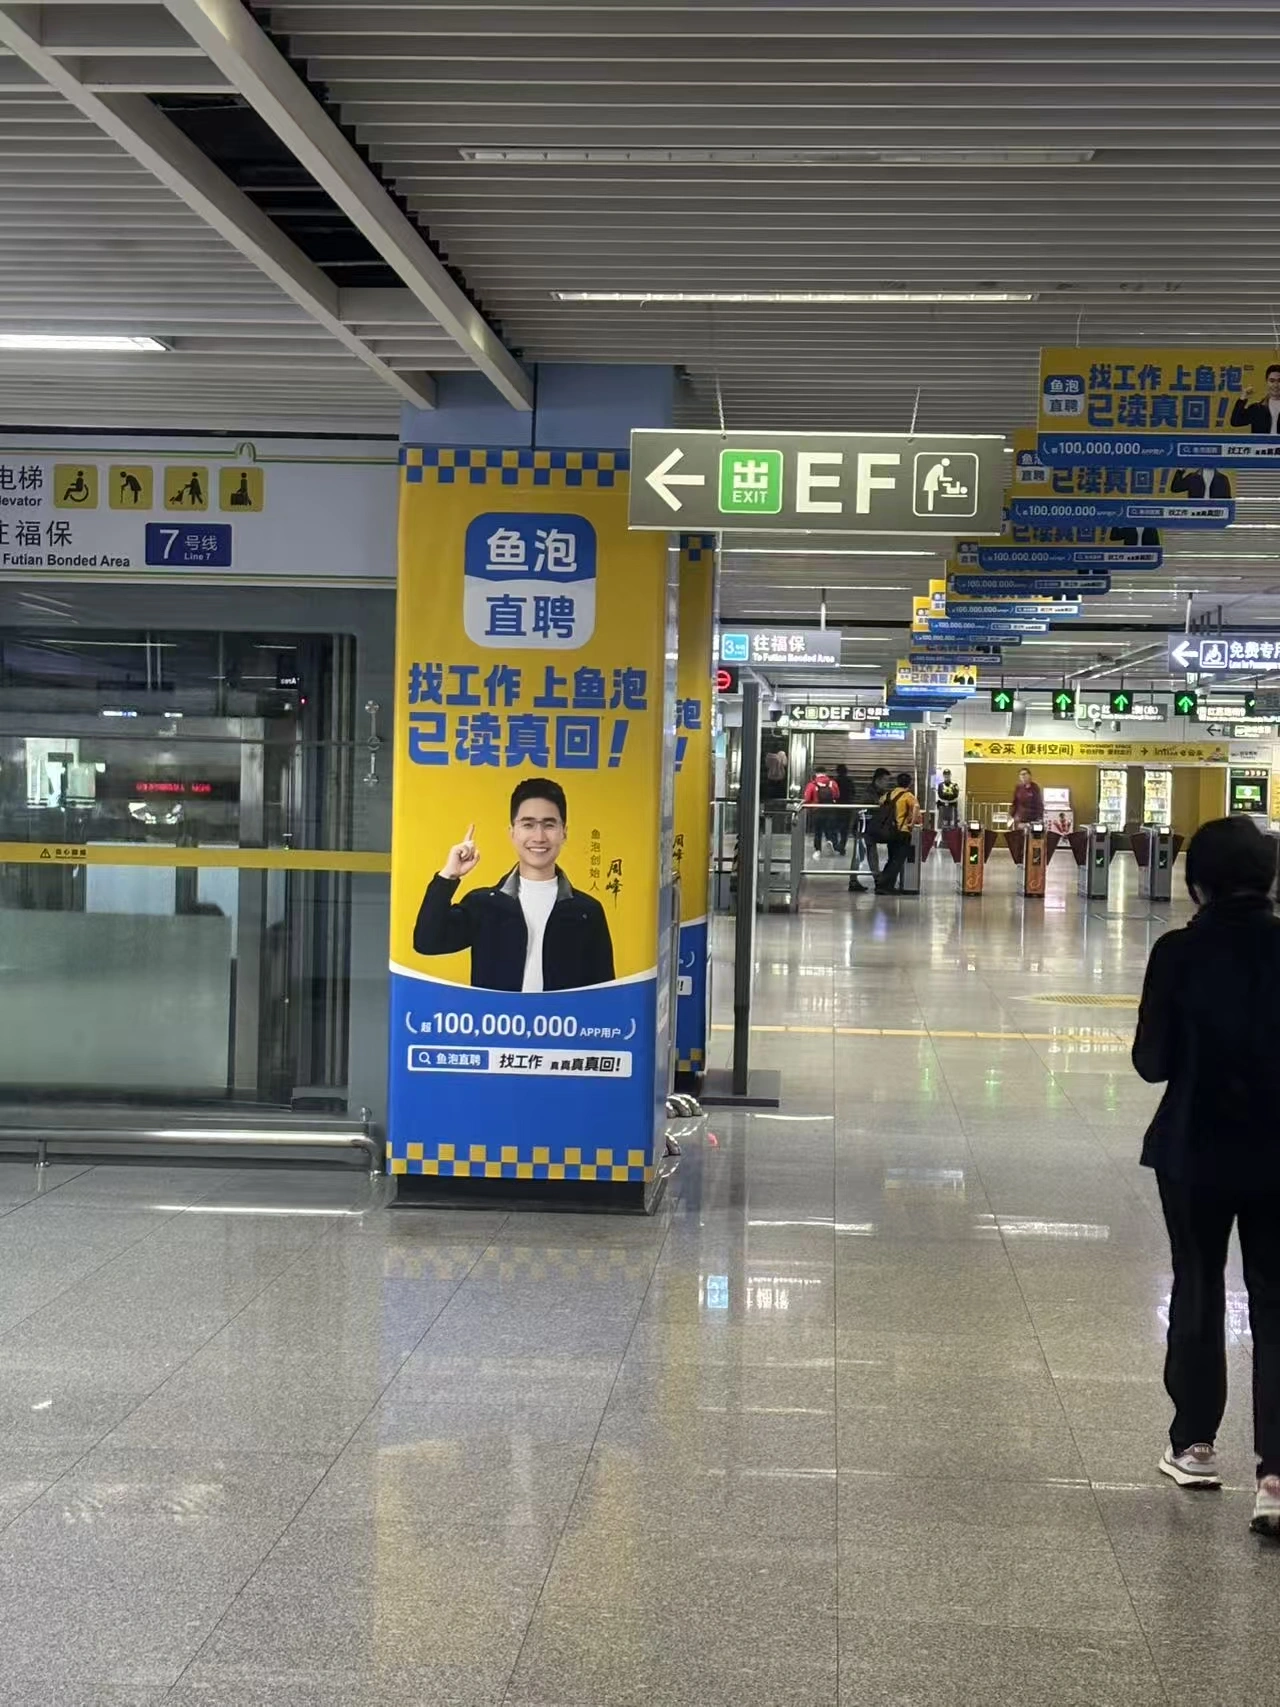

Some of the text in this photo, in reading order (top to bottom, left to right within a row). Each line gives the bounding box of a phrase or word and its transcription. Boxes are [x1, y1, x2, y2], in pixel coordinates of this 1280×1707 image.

[1050, 379, 1079, 393] 鱼泡
[1089, 363, 1243, 392] 找工作 上鱼泡
[1050, 398, 1079, 413] 直聘
[1088, 393, 1229, 429] 已读真回!
[0, 465, 43, 490] 电梯
[0, 495, 43, 507] levator
[732, 490, 768, 504] EXIT
[486, 527, 577, 573] 鱼泡
[3, 552, 131, 568] Futian Bonded Area
[485, 593, 575, 639] 直聘
[752, 634, 806, 652] 往福保
[408, 662, 648, 711] 找工作 上鱼泡
[818, 706, 851, 720] DEF
[1087, 703, 1101, 719] C
[408, 711, 630, 770] 已读真回!
[589, 828, 601, 892] 鱼泡创始人
[436, 1053, 482, 1067] 鱼泡直聘
[499, 1053, 543, 1070] 找工作
